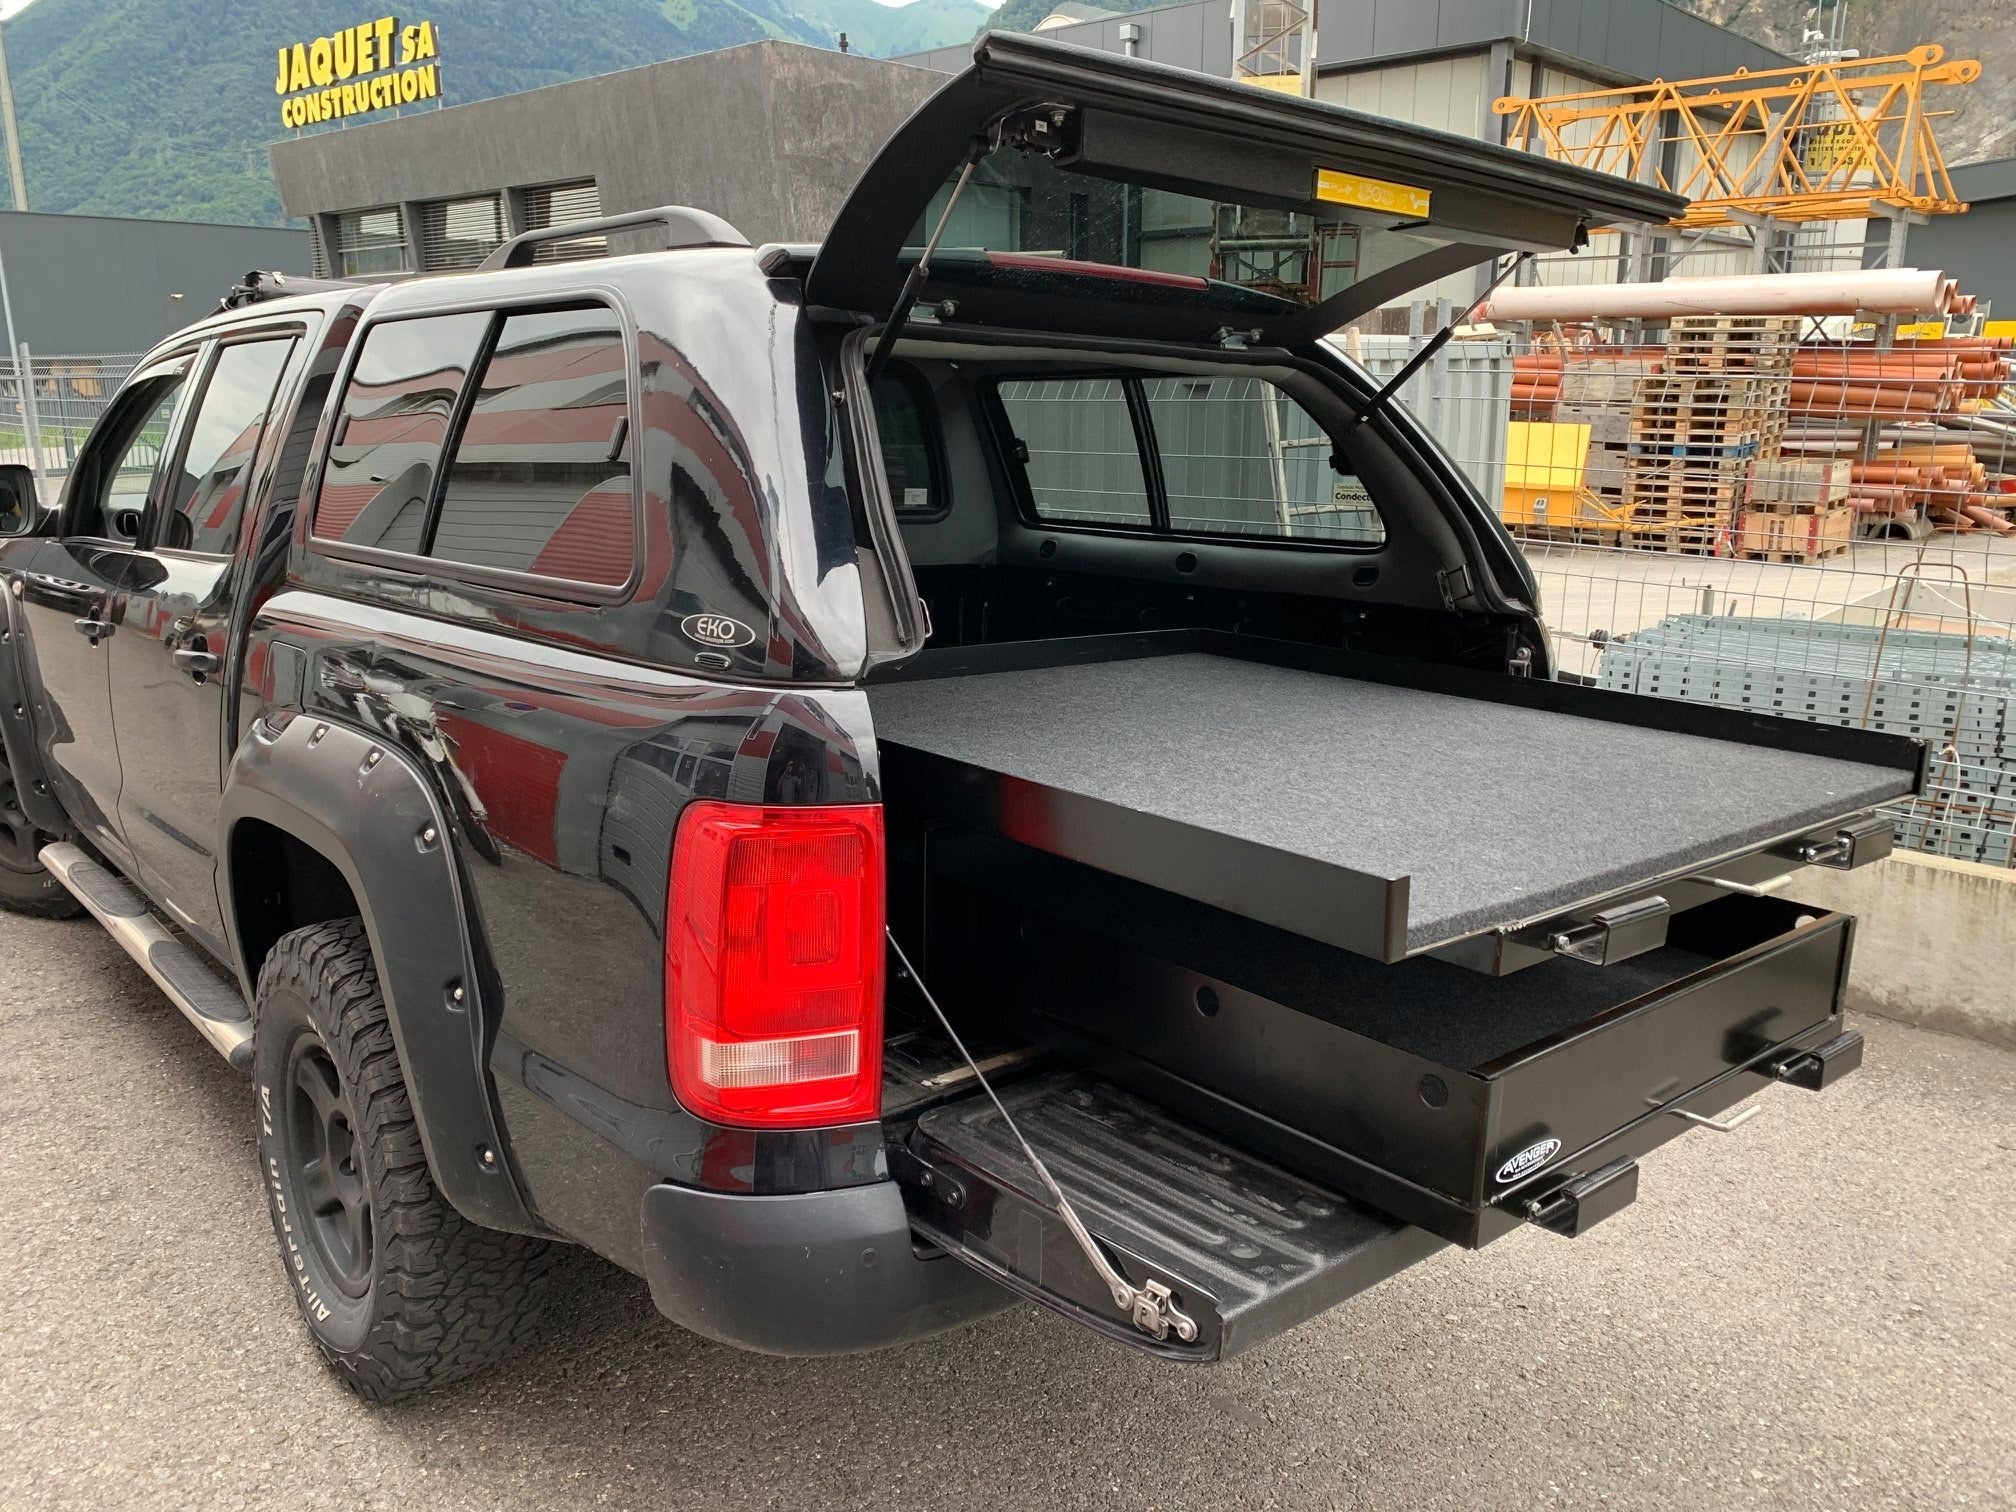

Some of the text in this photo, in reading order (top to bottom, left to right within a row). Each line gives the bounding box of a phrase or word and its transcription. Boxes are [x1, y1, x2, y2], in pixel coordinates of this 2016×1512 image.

[275, 16, 438, 95] JAQUET SA
[281, 64, 440, 129] CONSTRUCTION
[697, 617, 735, 639] EKO
[260, 1084, 274, 1138] T/A
[1503, 1141, 1554, 1175] AVENGER
